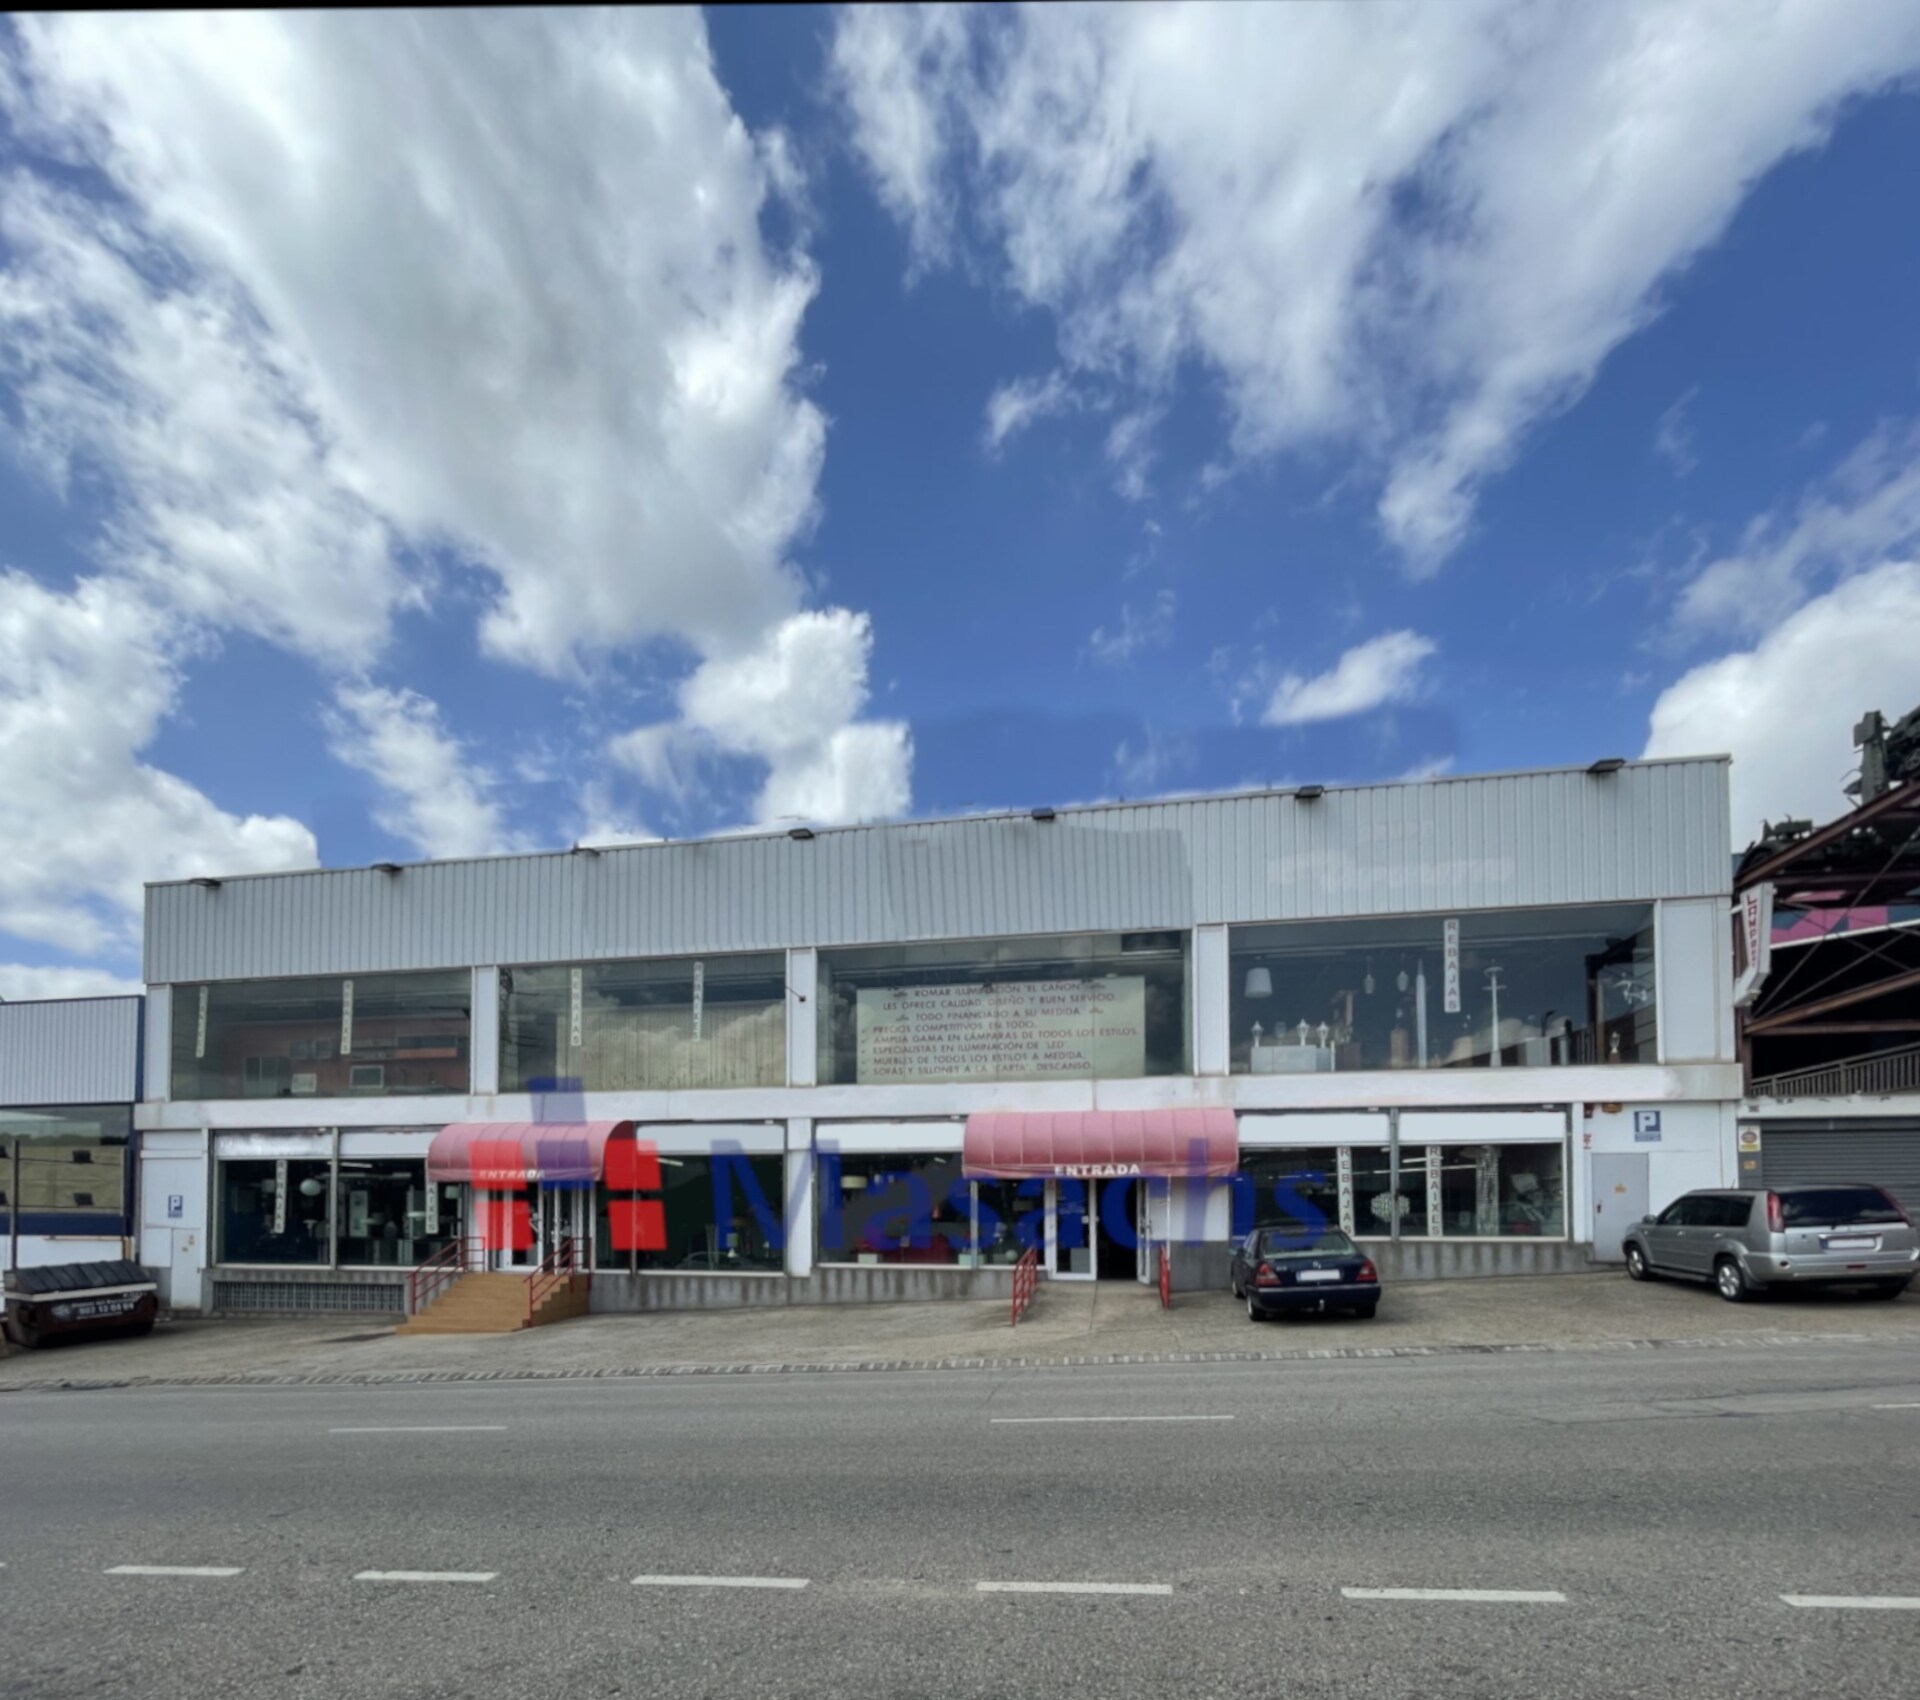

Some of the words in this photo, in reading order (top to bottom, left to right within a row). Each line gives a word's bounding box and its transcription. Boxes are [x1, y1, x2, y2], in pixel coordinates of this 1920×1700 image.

[1447, 921, 1458, 1010] REBAJAS
[571, 970, 582, 1043] REBAJAS
[883, 1002, 897, 1011] LES
[901, 1000, 936, 1010] OFRECE
[1029, 996, 1035, 1005] Y
[1039, 995, 1066, 1005] BUEN
[915, 1012, 943, 1021] TODO
[947, 1009, 1009, 1020] FINANCIADO
[1013, 1009, 1020, 1017] A
[1024, 1008, 1037, 1017] SU
[873, 1025, 911, 1034] PRECIOS
[915, 1021, 983, 1032] COMPETITIVOS
[989, 1020, 1002, 1029] EN
[912, 1034, 943, 1043] GAMA
[947, 1033, 960, 1042] EN
[1021, 1030, 1033, 1039] DE
[1039, 1029, 1072, 1039] TODOS
[1076, 1028, 1095, 1037] LOS
[873, 1044, 937, 1055] ESPECIALISTAS
[941, 1044, 954, 1053] EN
[1026, 1041, 1039, 1050] DE
[873, 1055, 913, 1065] MUEBLES
[917, 1055, 929, 1064] DE
[933, 1054, 966, 1063] TODOS
[970, 1053, 988, 1063] LOS
[992, 1052, 1027, 1062] ESTILOS
[1031, 1052, 1039, 1060] A
[906, 1066, 913, 1075] Y
[918, 1064, 959, 1075] SILLONES
[963, 1064, 971, 1073] A
[975, 1063, 987, 1073] LA
[1637, 1111, 1658, 1133] P
[478, 1169, 546, 1180] ENTRADA
[1053, 1163, 1141, 1177] ENTRADA
[275, 1160, 287, 1230] REBAJAS
[1340, 1147, 1353, 1234] REBAJAS
[1430, 1146, 1441, 1236] REBAIXES
[170, 1194, 181, 1212] P
